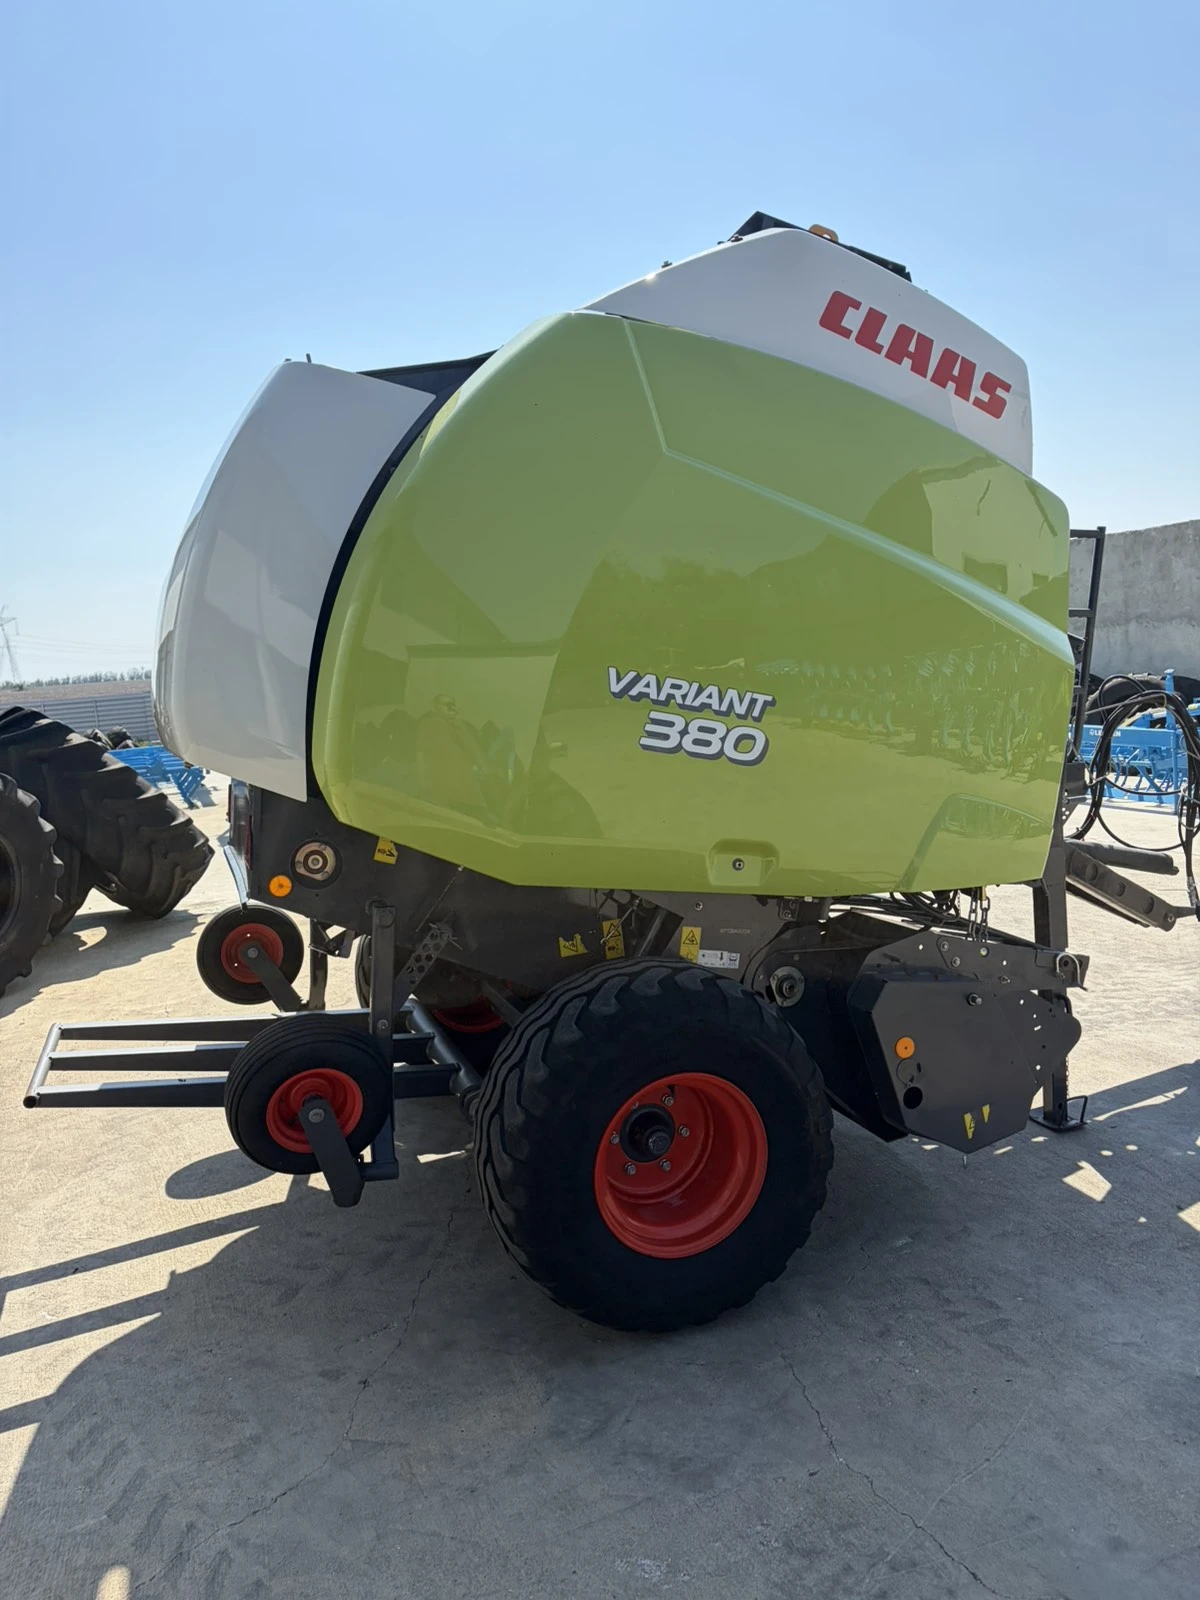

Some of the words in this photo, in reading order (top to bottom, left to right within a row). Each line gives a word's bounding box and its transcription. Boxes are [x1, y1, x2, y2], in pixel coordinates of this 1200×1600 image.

[819, 290, 1012, 420] CLAAS
[607, 666, 777, 723] VARIANT
[638, 710, 769, 767] 380
